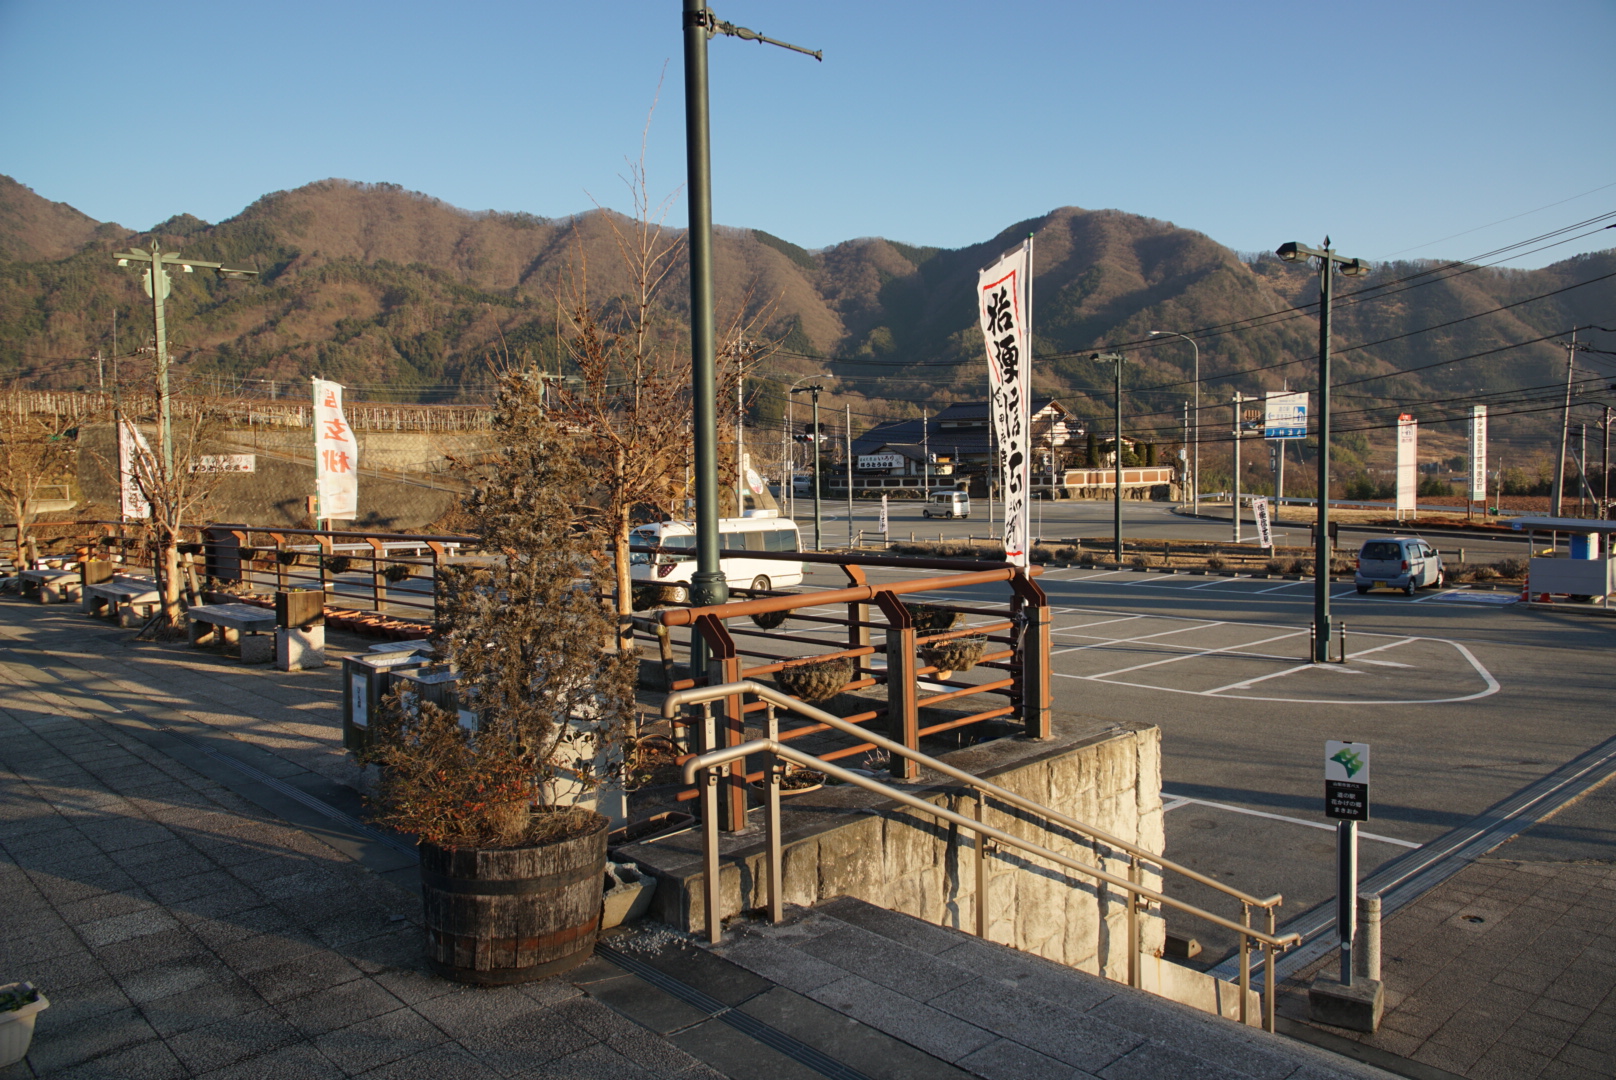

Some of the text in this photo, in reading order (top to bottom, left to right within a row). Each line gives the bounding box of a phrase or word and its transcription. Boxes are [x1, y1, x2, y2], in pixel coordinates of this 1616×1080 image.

[1330, 799, 1362, 808] 花かげの郷
[1334, 807, 1359, 815] まきおか
